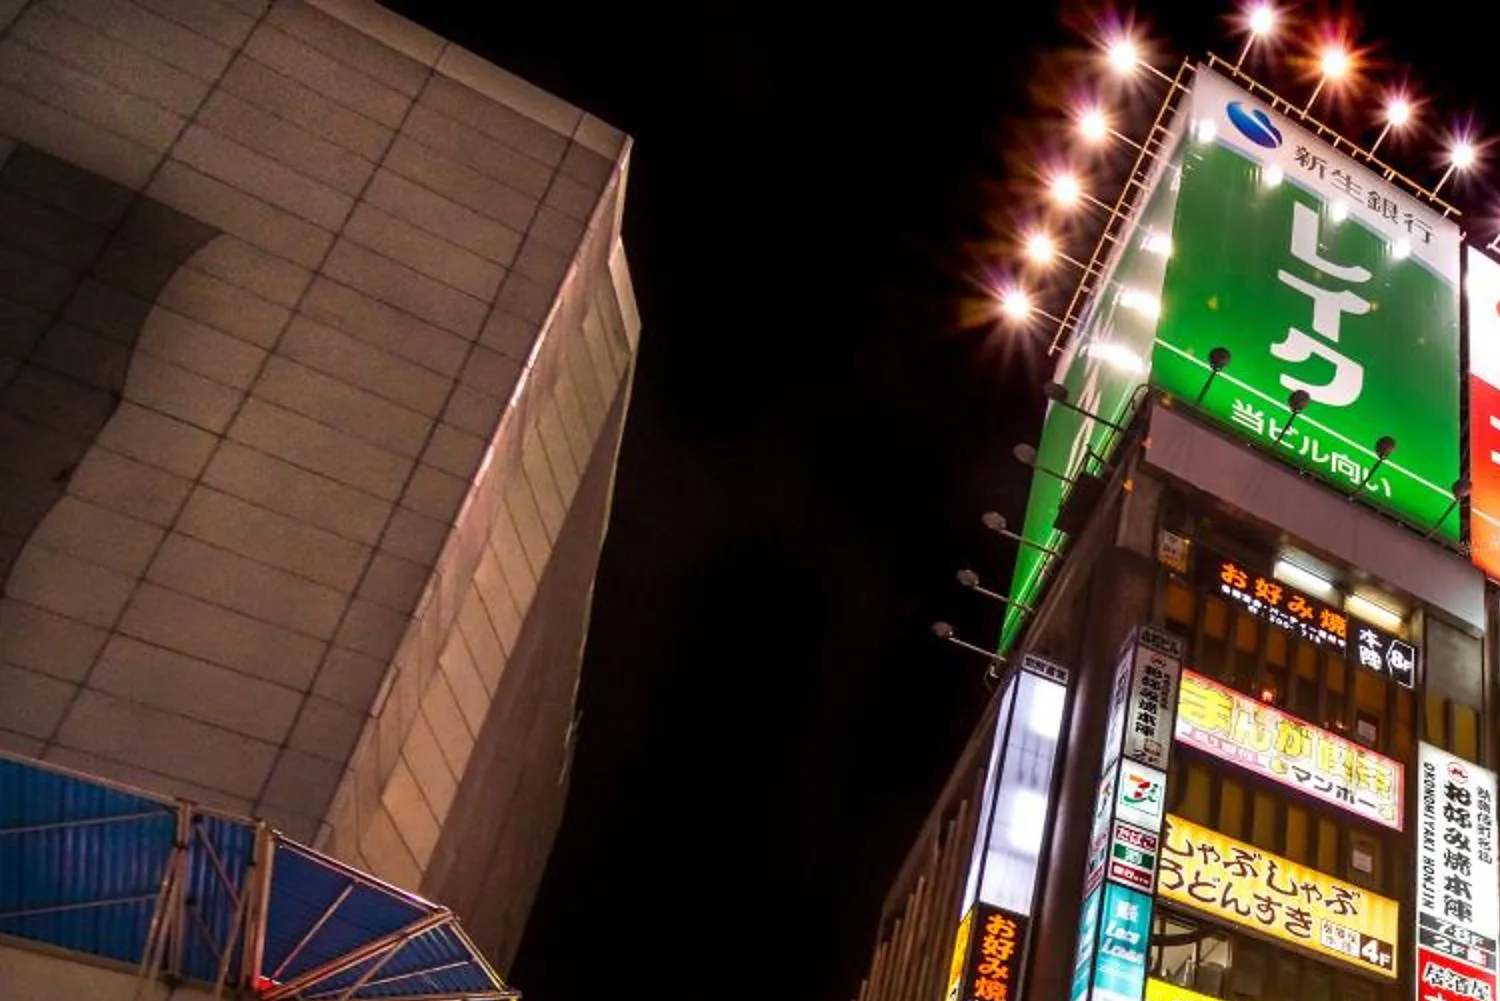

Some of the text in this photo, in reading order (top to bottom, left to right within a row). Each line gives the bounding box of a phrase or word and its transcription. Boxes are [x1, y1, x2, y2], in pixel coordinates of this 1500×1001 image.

[1294, 142, 1438, 248] 新生銀行
[1270, 200, 1373, 407] レイク
[1231, 398, 1393, 498] 当ビル向い
[1219, 561, 1349, 639] お好み焼
[1157, 857, 1314, 940] うどんすき
[1160, 820, 1363, 917] しゃぶしゃぶ
[1360, 940, 1392, 968] 4F
